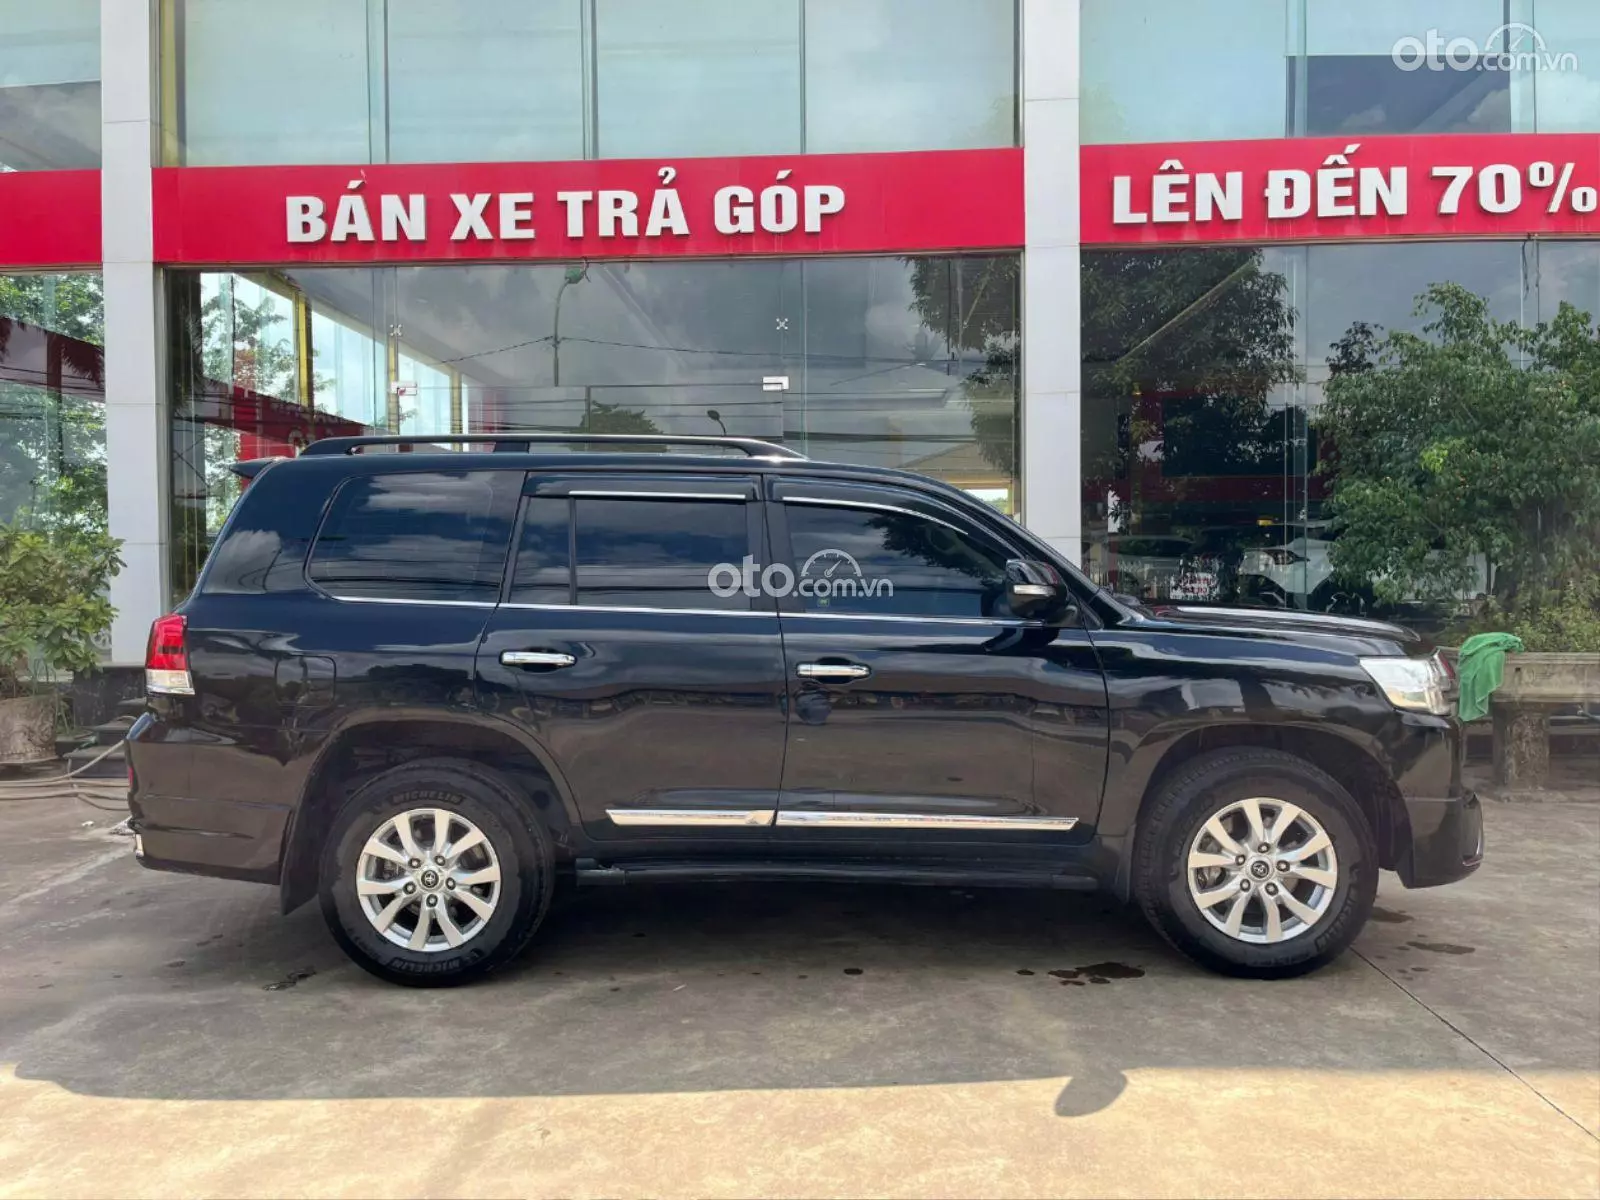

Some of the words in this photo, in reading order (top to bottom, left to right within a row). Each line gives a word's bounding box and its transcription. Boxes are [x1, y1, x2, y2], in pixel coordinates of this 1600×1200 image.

[286, 180, 427, 243] BÁN
[450, 193, 536, 242] XE
[557, 166, 690, 239] TRẢ
[713, 169, 846, 235] GÓP
[1112, 160, 1244, 225] LÊN
[1264, 144, 1408, 220] ĐẾN
[1430, 162, 1598, 216] 70%
[392, 789, 462, 805] MICHELIN
